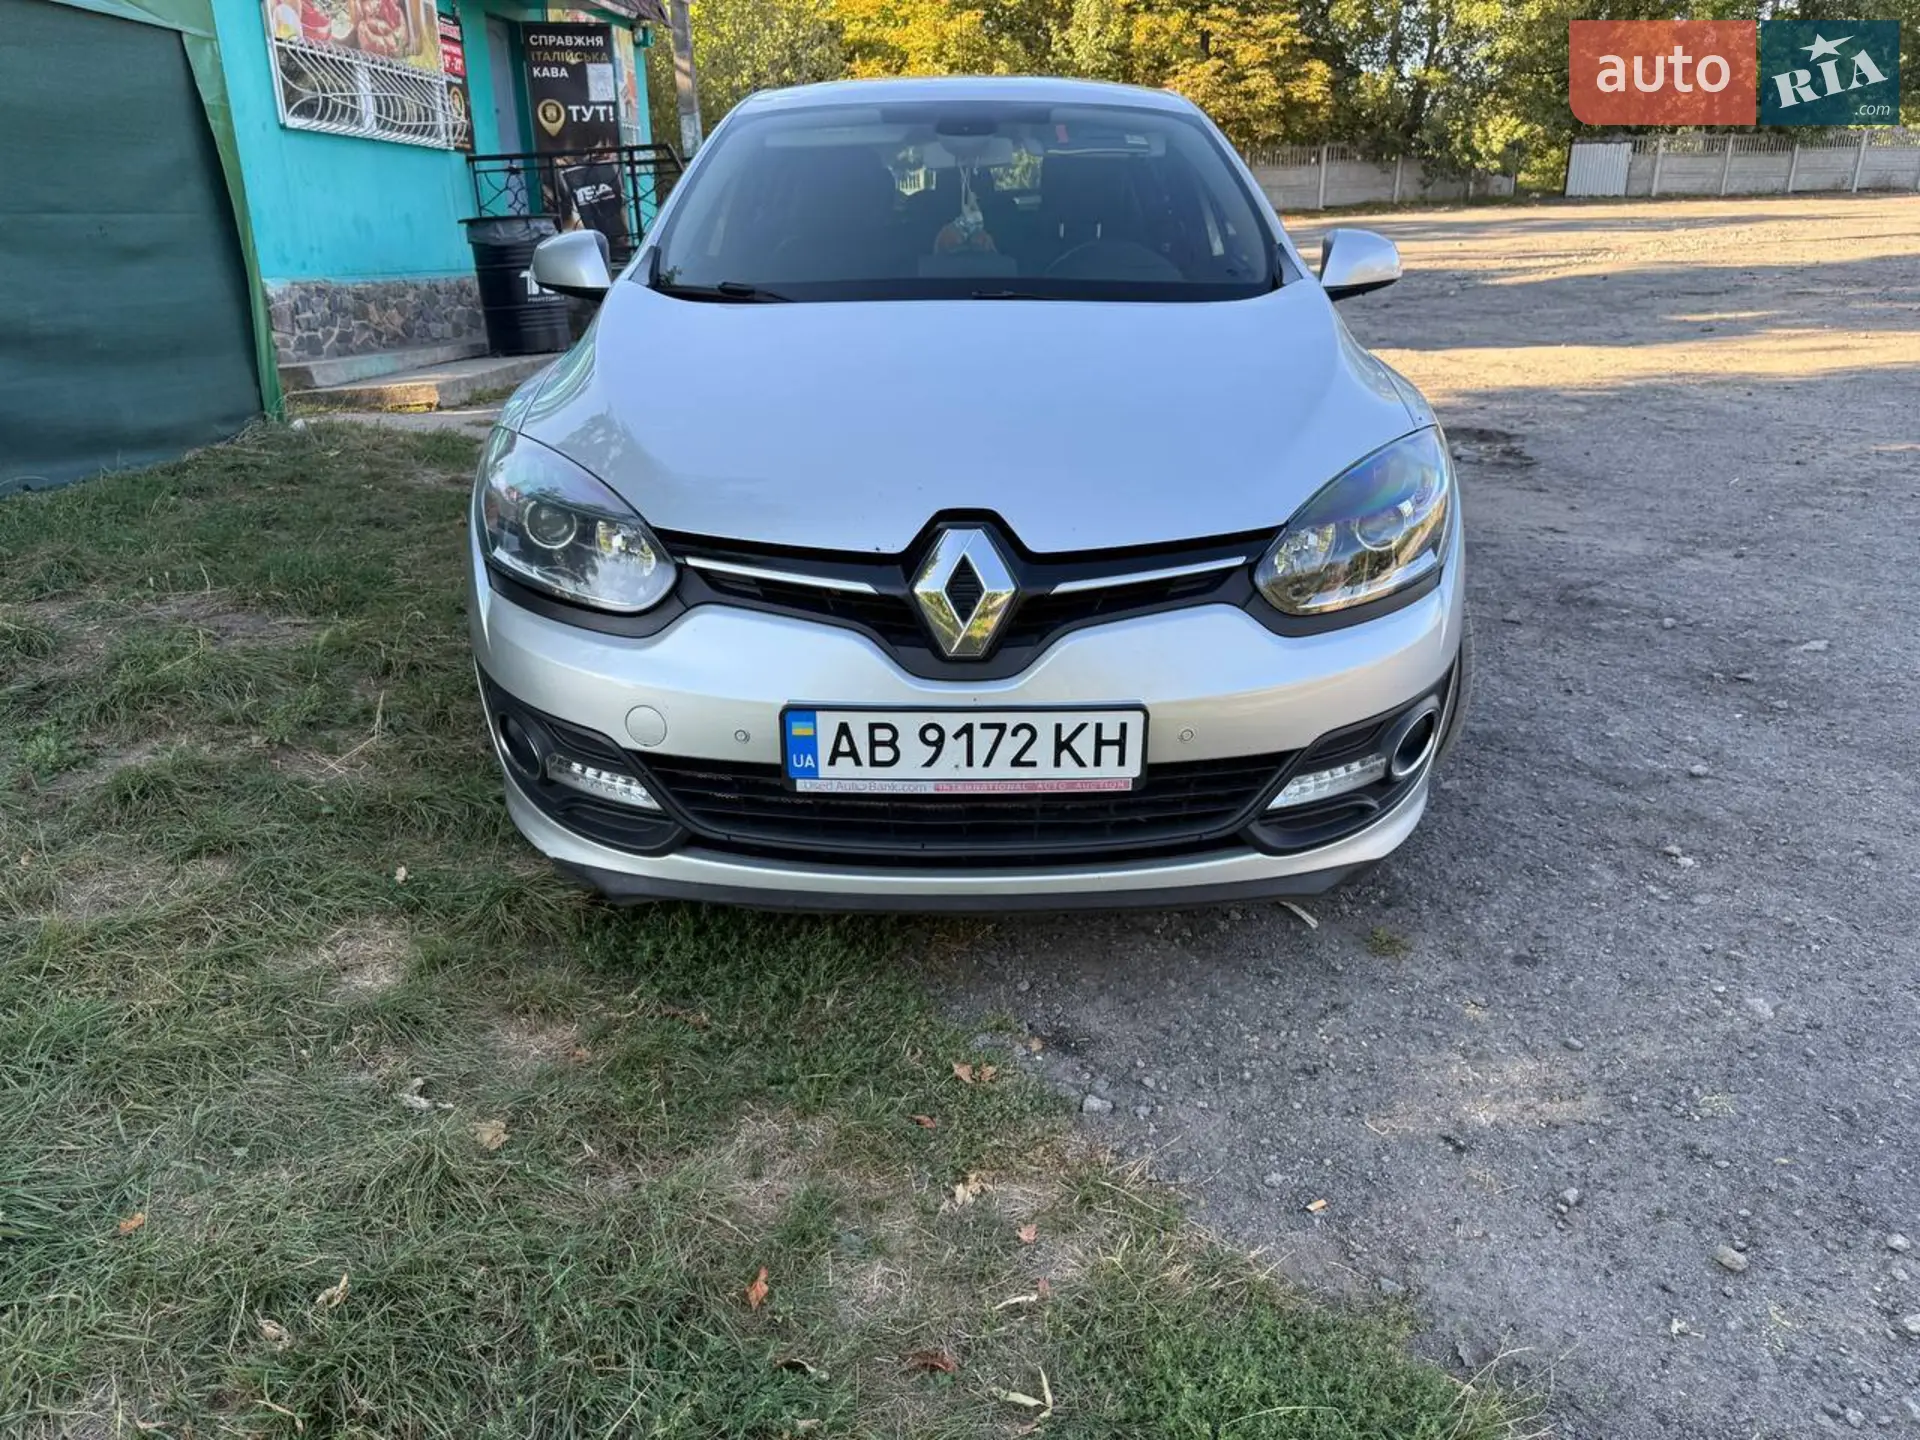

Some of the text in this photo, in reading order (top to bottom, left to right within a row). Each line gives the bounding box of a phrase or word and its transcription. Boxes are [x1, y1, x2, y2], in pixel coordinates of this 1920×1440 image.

[529, 34, 604, 47] СПРАВЖНЯ
[531, 49, 609, 62] ІТАЛІЙСЬКА
[532, 66, 569, 78] КАВА
[567, 105, 615, 122] ТУТ!
[827, 721, 1128, 768] AB 9172 KH
[792, 754, 816, 769] UA
